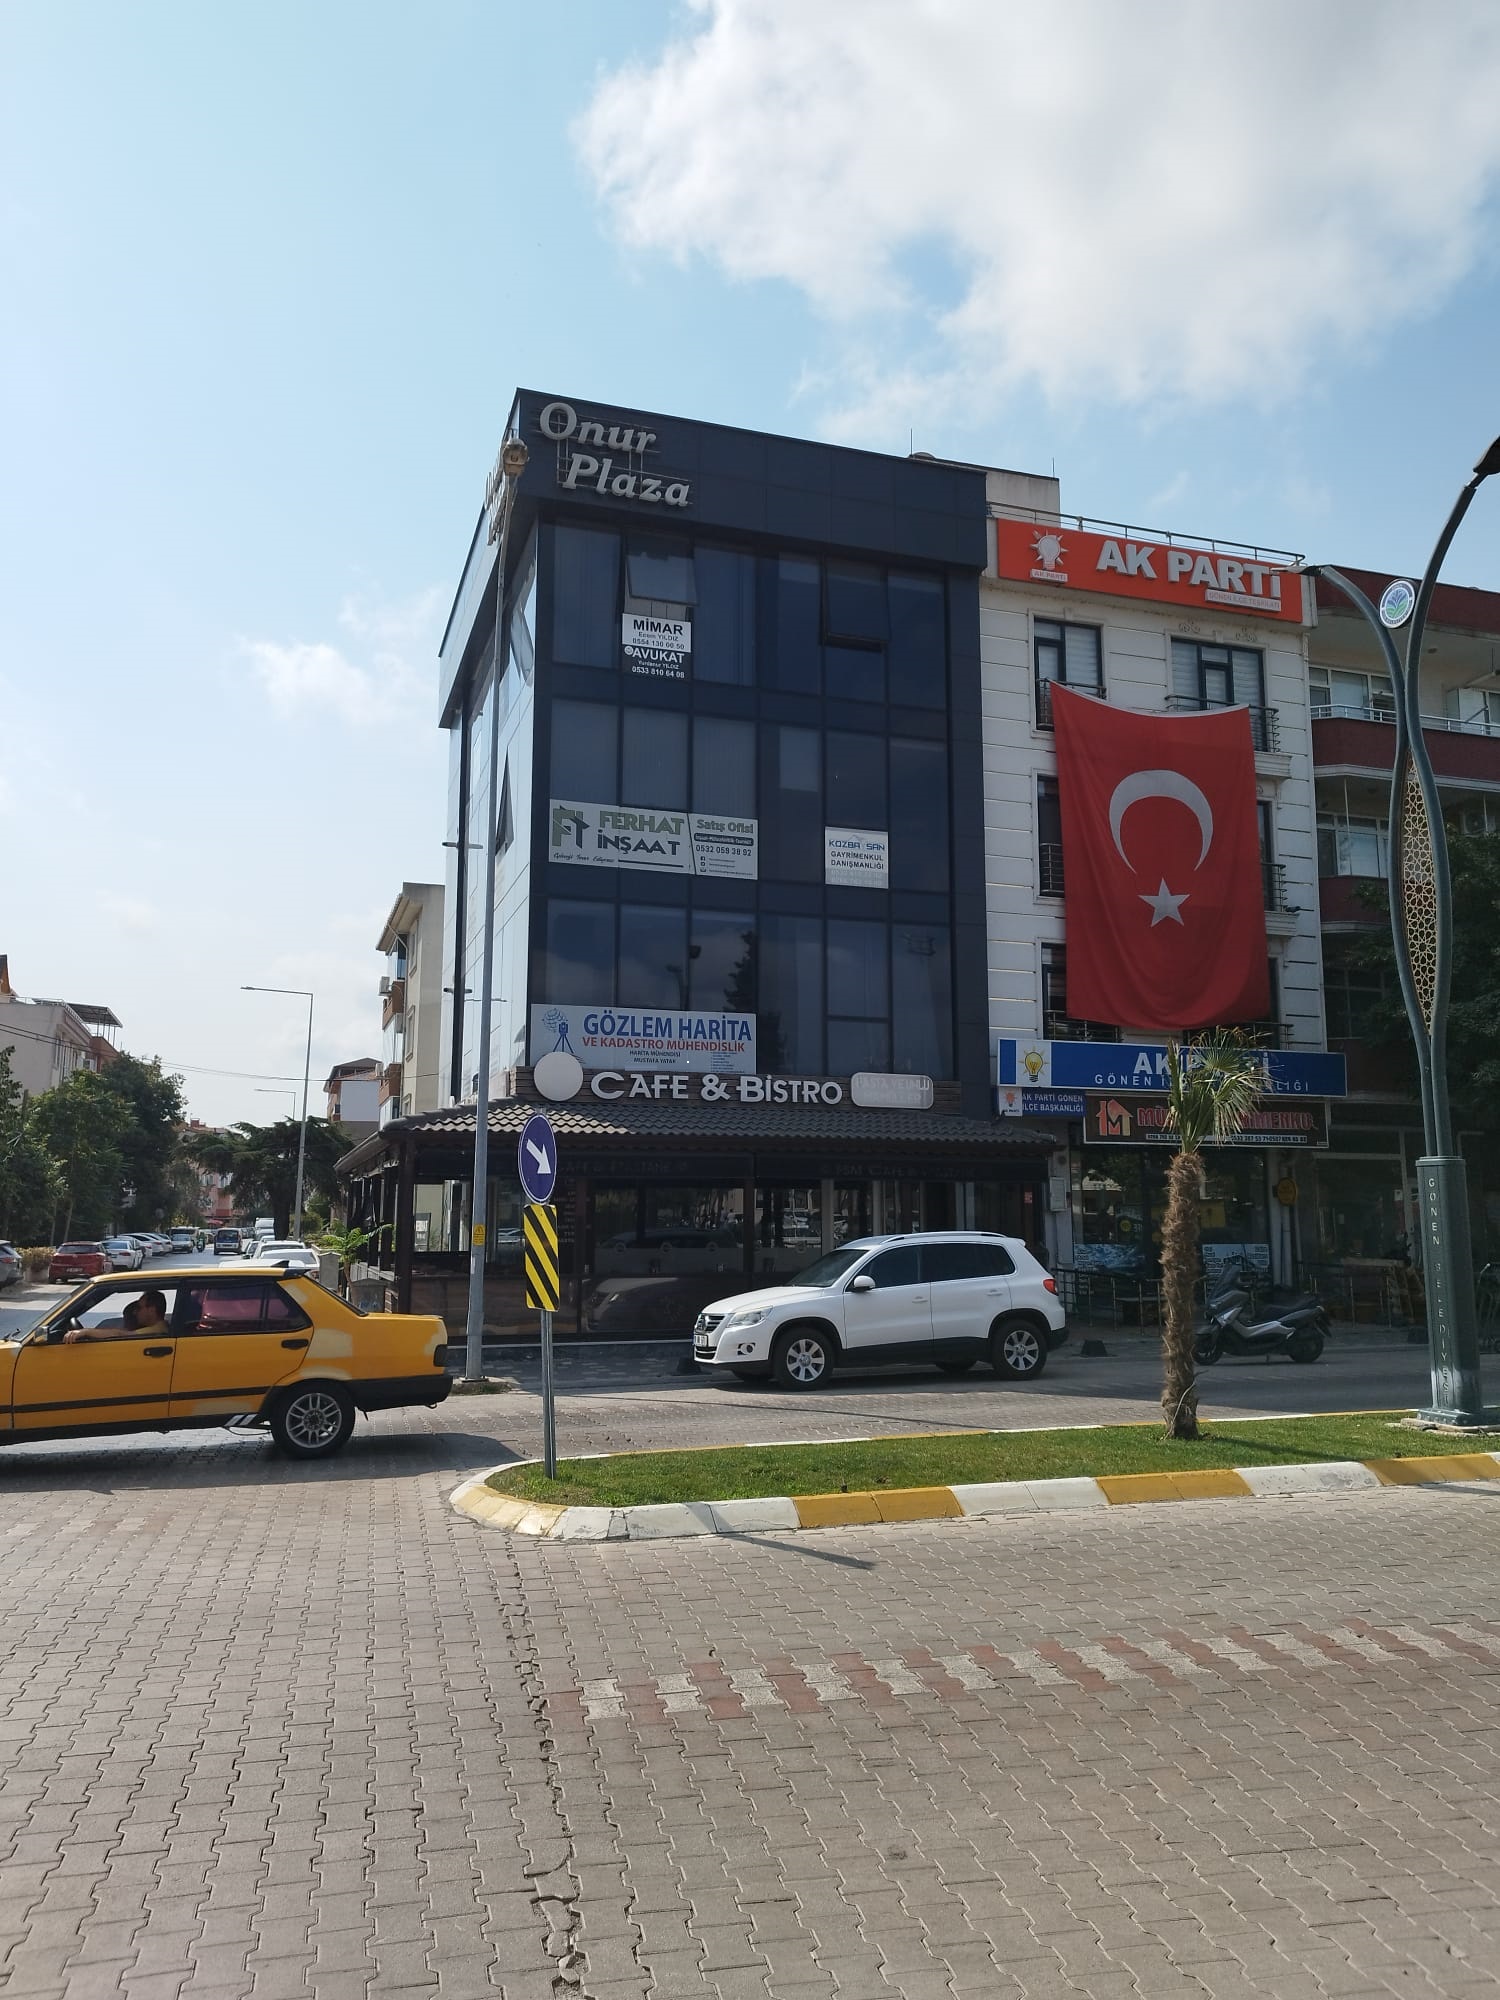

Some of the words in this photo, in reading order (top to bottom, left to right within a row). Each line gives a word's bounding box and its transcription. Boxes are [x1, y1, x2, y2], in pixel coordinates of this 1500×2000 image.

[539, 402, 657, 453] Onur
[562, 452, 691, 506] Plaza
[1096, 540, 1158, 579] AK
[633, 618, 683, 635] MİMAR
[632, 648, 685, 663] AVUKAT
[599, 810, 685, 835] FERHAT
[598, 829, 681, 856] İNŞAAT
[695, 844, 714, 853] 0532
[742, 848, 752, 857] 92
[866, 843, 885, 851] SAN
[583, 1009, 673, 1039] GÖZLEM
[678, 1014, 752, 1041] HARİTA
[582, 1036, 598, 1047] VE
[600, 1037, 664, 1050] KADASTRO
[666, 1038, 745, 1052] MÜHENDİSLİK
[1133, 1052, 1172, 1075] AK
[590, 1071, 689, 1100] CAFE
[700, 1074, 731, 1101] &
[736, 1074, 843, 1105] BİSTRO
[1094, 1072, 1152, 1086] GÖNEN
[1023, 1093, 1032, 1101] AK
